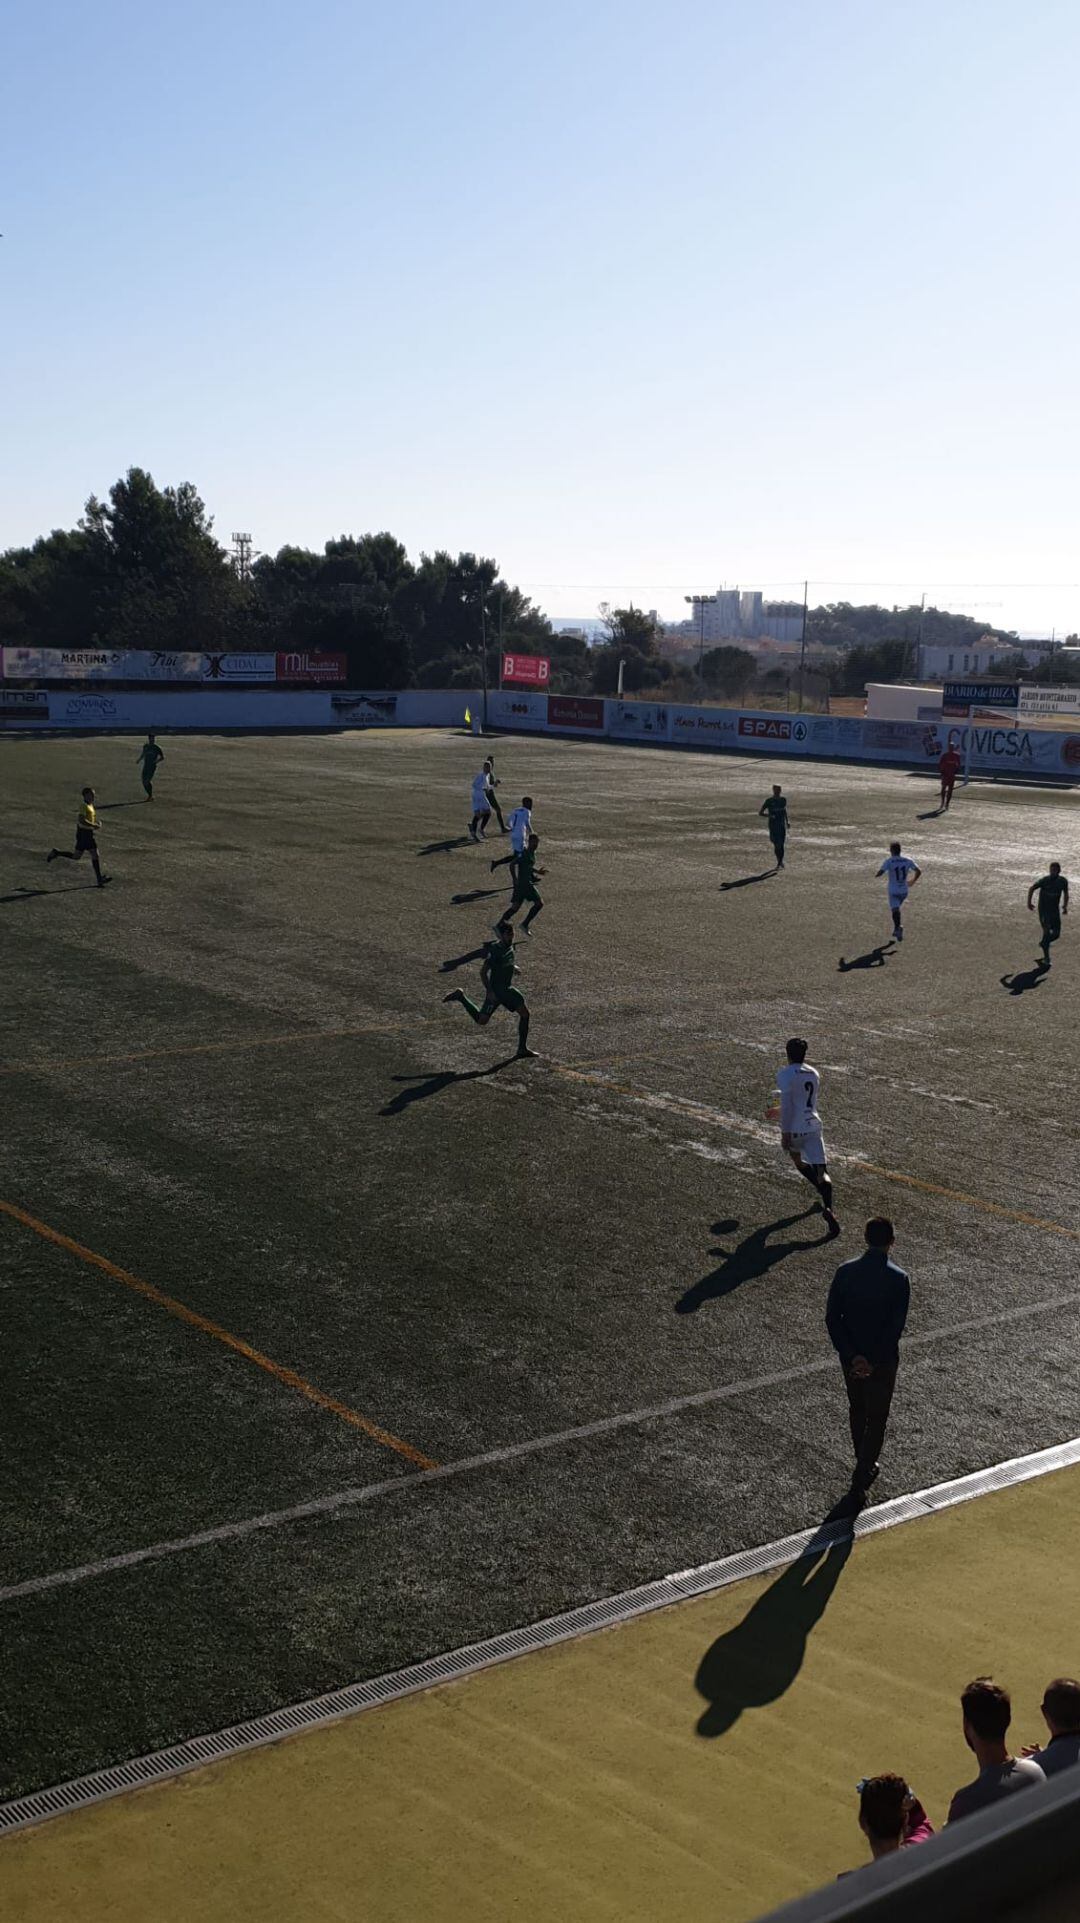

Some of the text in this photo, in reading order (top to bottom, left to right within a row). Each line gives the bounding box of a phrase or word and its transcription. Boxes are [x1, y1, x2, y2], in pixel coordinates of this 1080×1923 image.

[61, 653, 107, 665] MARTINA
[504, 657, 514, 675] B
[538, 660, 548, 680] B
[944, 685, 1017, 698] DIARIO de IBIZA
[743, 721, 790, 737] SPAR
[948, 728, 1033, 757] COVICSA
[894, 865, 906, 881] 11
[804, 1081, 813, 1108] 2
